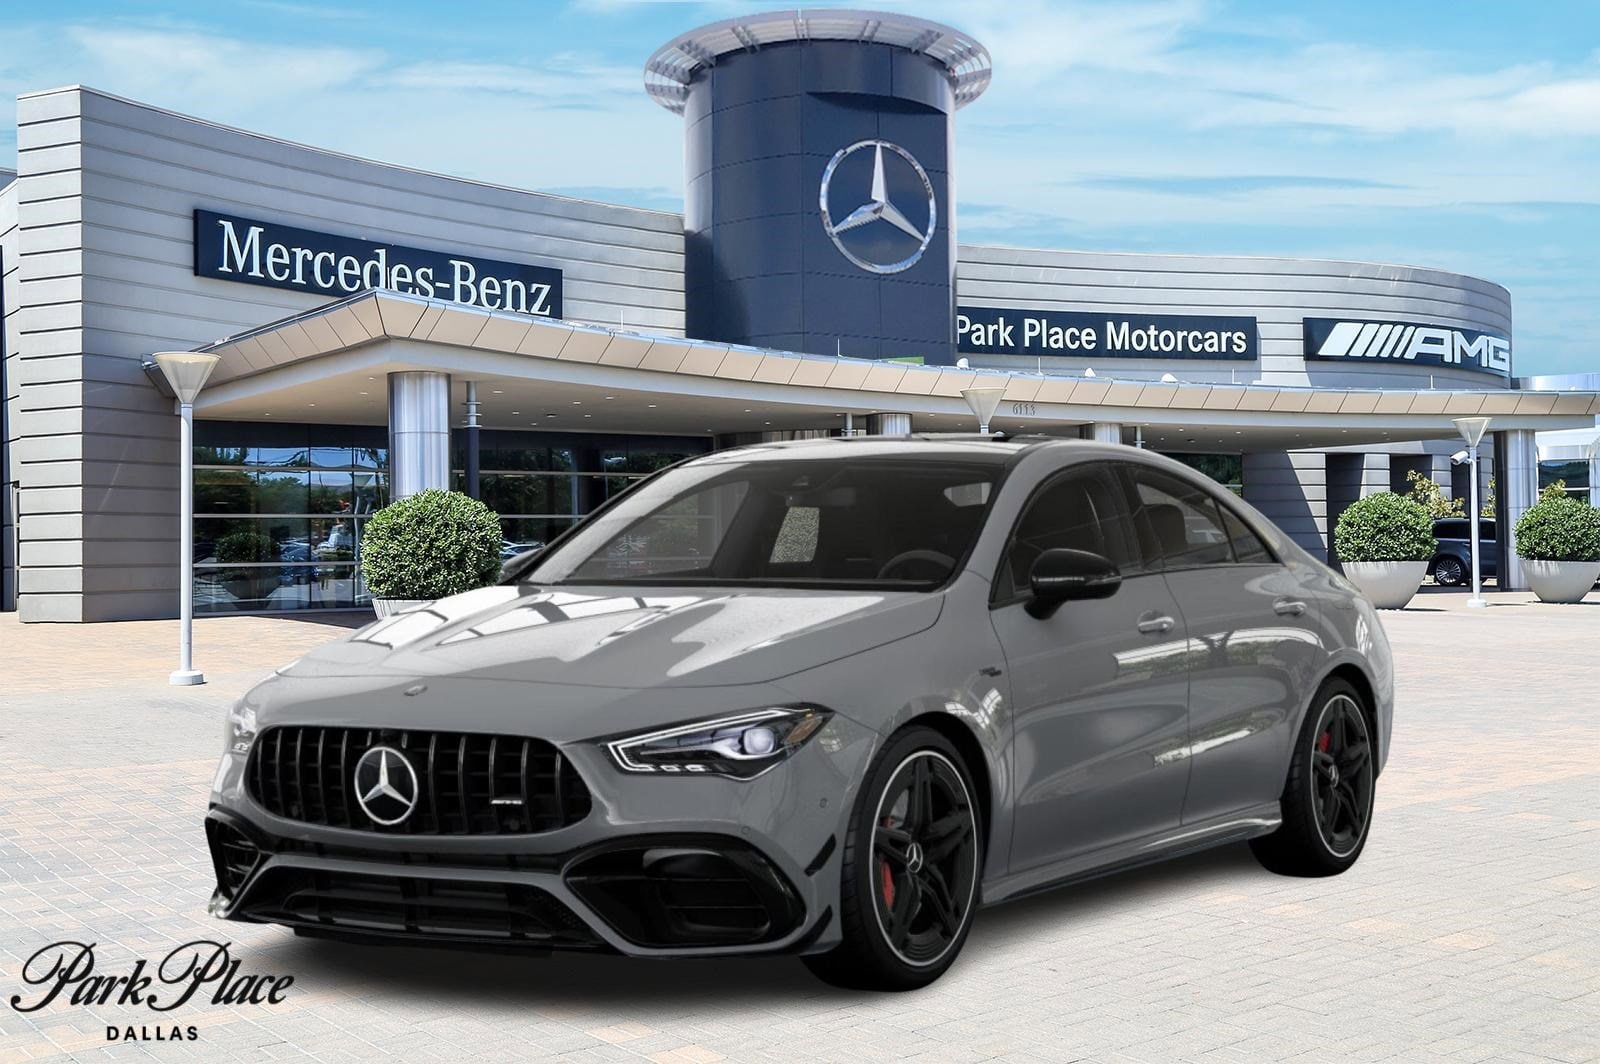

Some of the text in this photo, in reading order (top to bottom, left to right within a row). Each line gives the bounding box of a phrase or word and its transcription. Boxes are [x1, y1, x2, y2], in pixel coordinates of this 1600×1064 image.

[217, 219, 552, 316] Mercedes-Benz
[957, 314, 1247, 353] Park Place Motorcars
